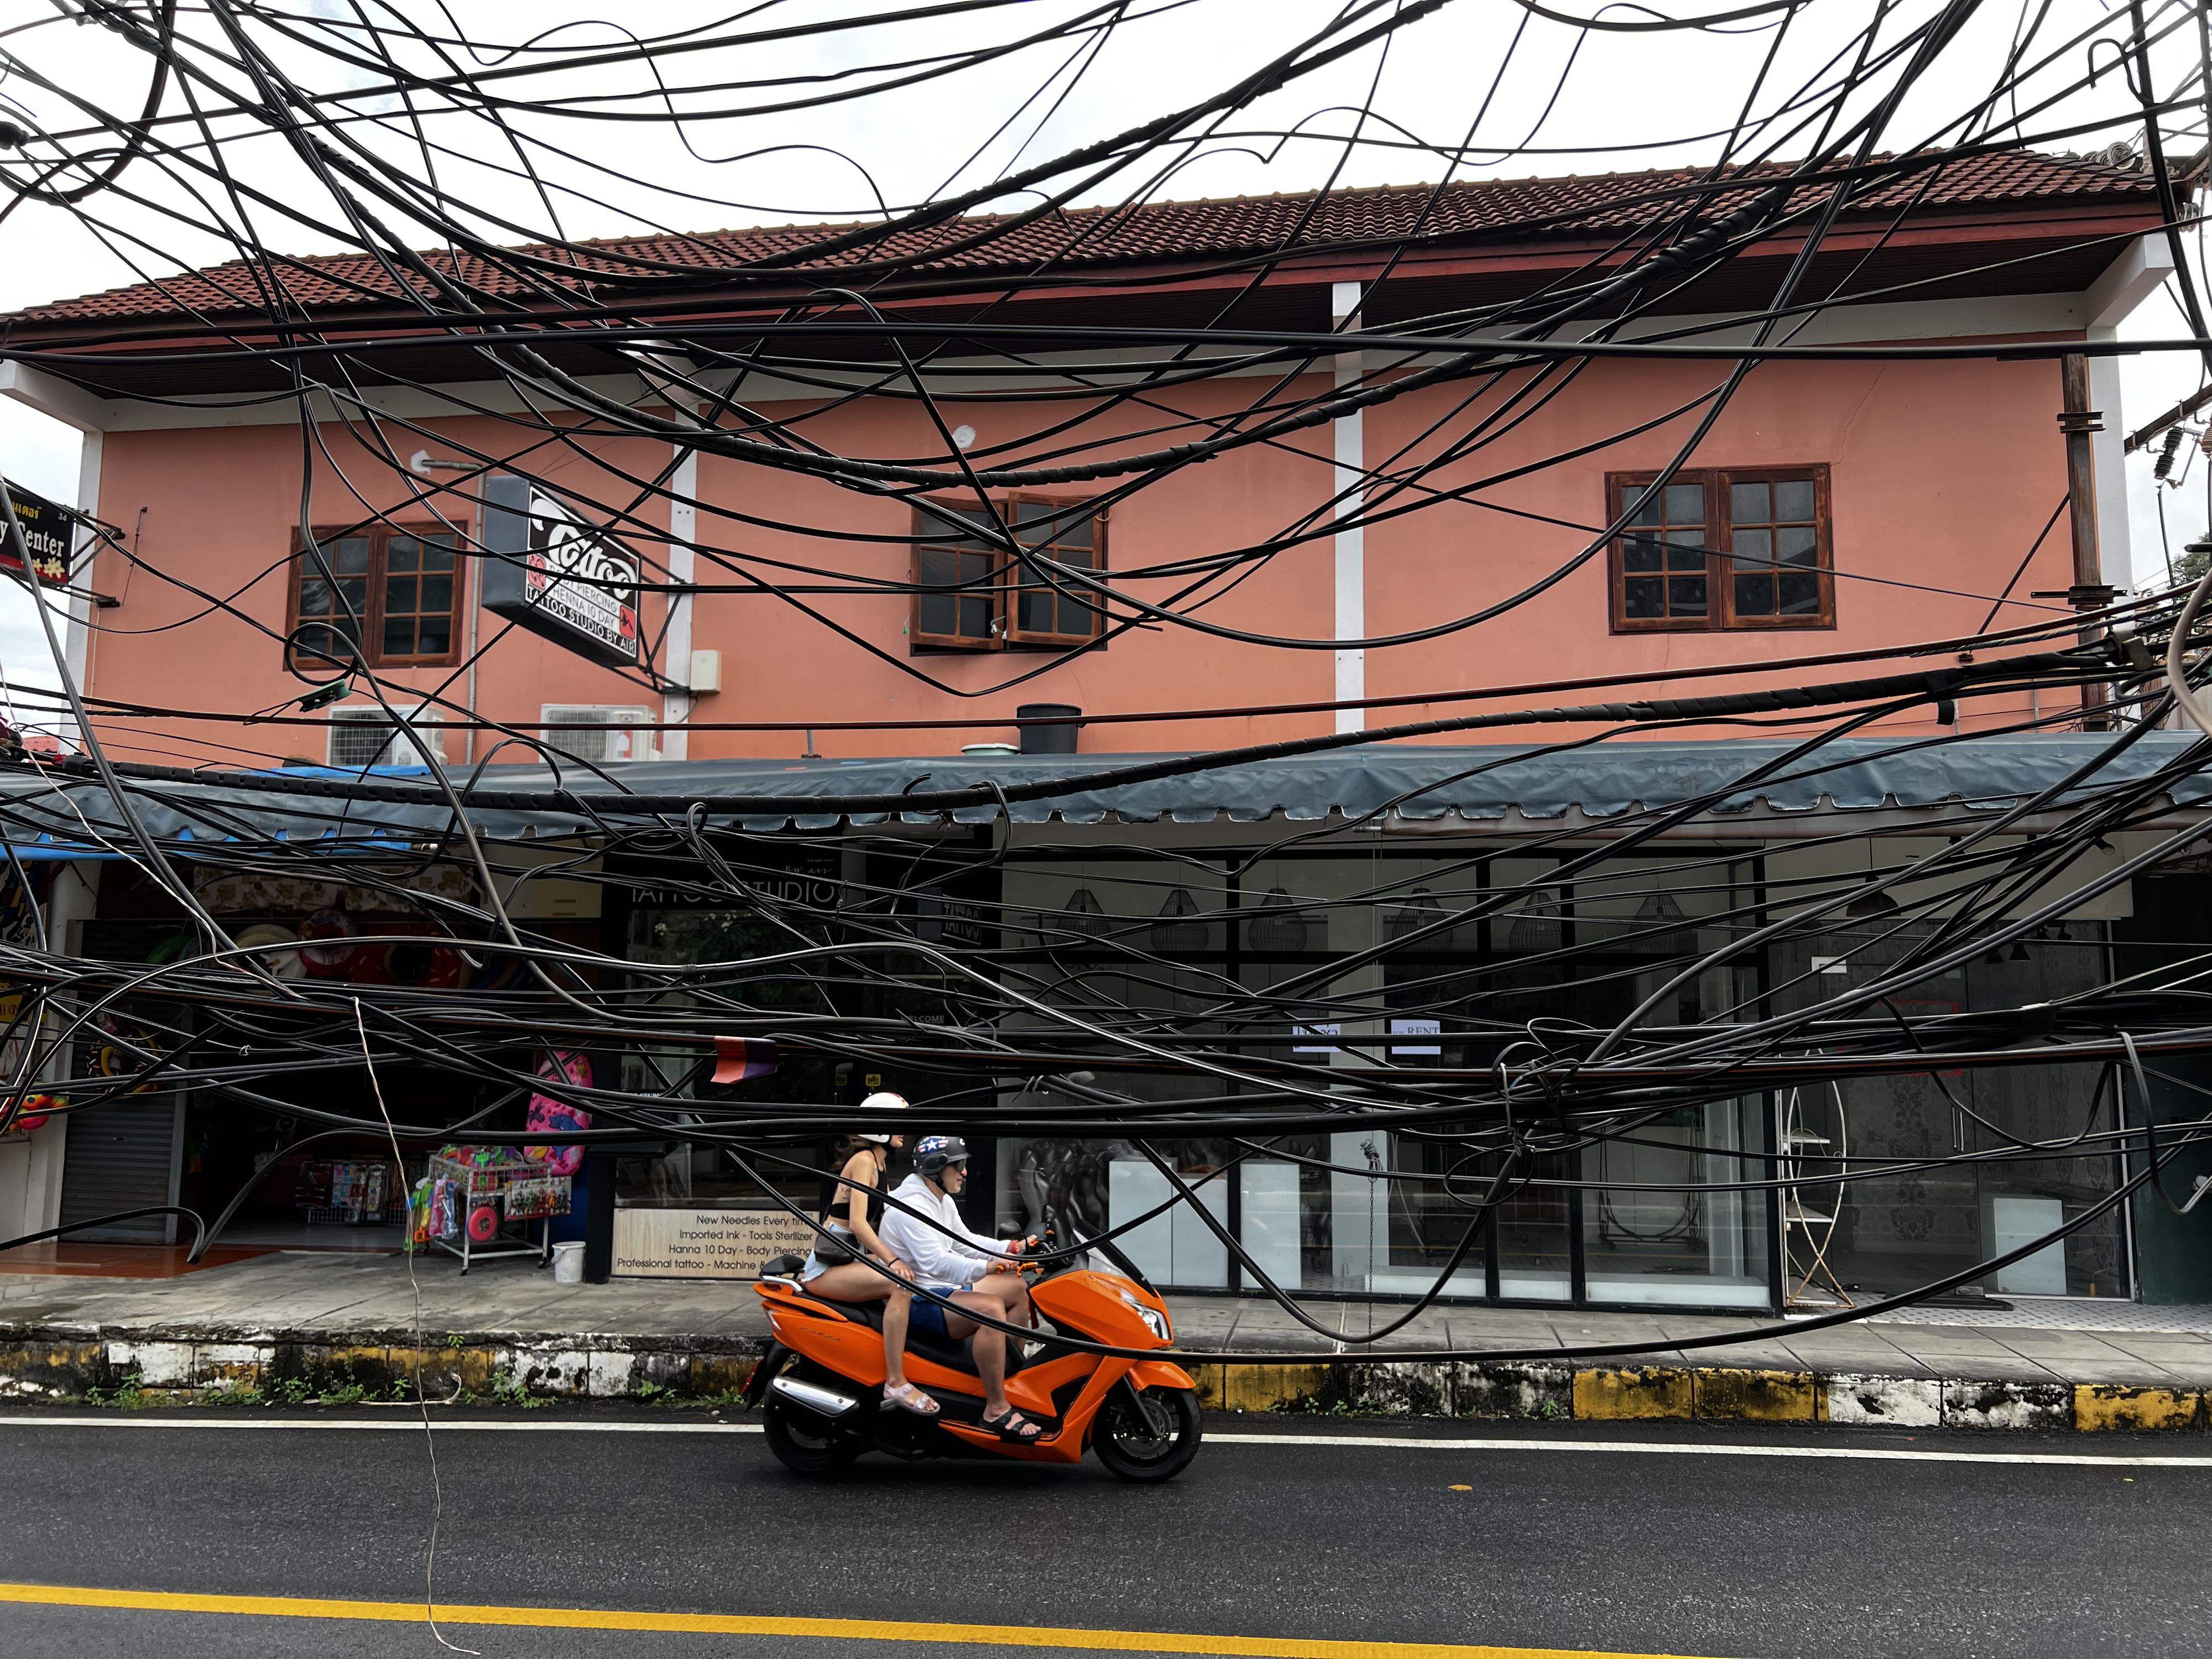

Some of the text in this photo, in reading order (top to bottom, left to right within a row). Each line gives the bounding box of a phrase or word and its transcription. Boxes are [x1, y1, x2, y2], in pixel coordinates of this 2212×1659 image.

[58, 512, 67, 521] 34
[531, 499, 637, 600] Tattoo
[553, 586, 585, 611] HENNA
[598, 610, 615, 628] DAY
[577, 582, 617, 613] PIERCING
[568, 609, 604, 637] STUDIO
[607, 629, 618, 644] BY
[620, 638, 635, 655] AIR
[740, 880, 835, 903] TUDIO
[944, 903, 979, 940] TATTOO
[697, 1215, 718, 1224] New
[722, 1215, 760, 1225] Needles
[764, 1216, 789, 1227] Every
[680, 1229, 723, 1240] Imported
[727, 1230, 740, 1239] Ink
[749, 1230, 773, 1240] Tools
[775, 1231, 813, 1241] Sterilizer
[669, 1244, 700, 1254] Hanna
[705, 1245, 715, 1254] 10
[718, 1245, 737, 1256] Day
[747, 1246, 771, 1256] Body
[774, 1246, 812, 1258] Piercing
[618, 1258, 671, 1268] Professional
[675, 1259, 704, 1268] tattoo
[714, 1260, 756, 1269] Machine
